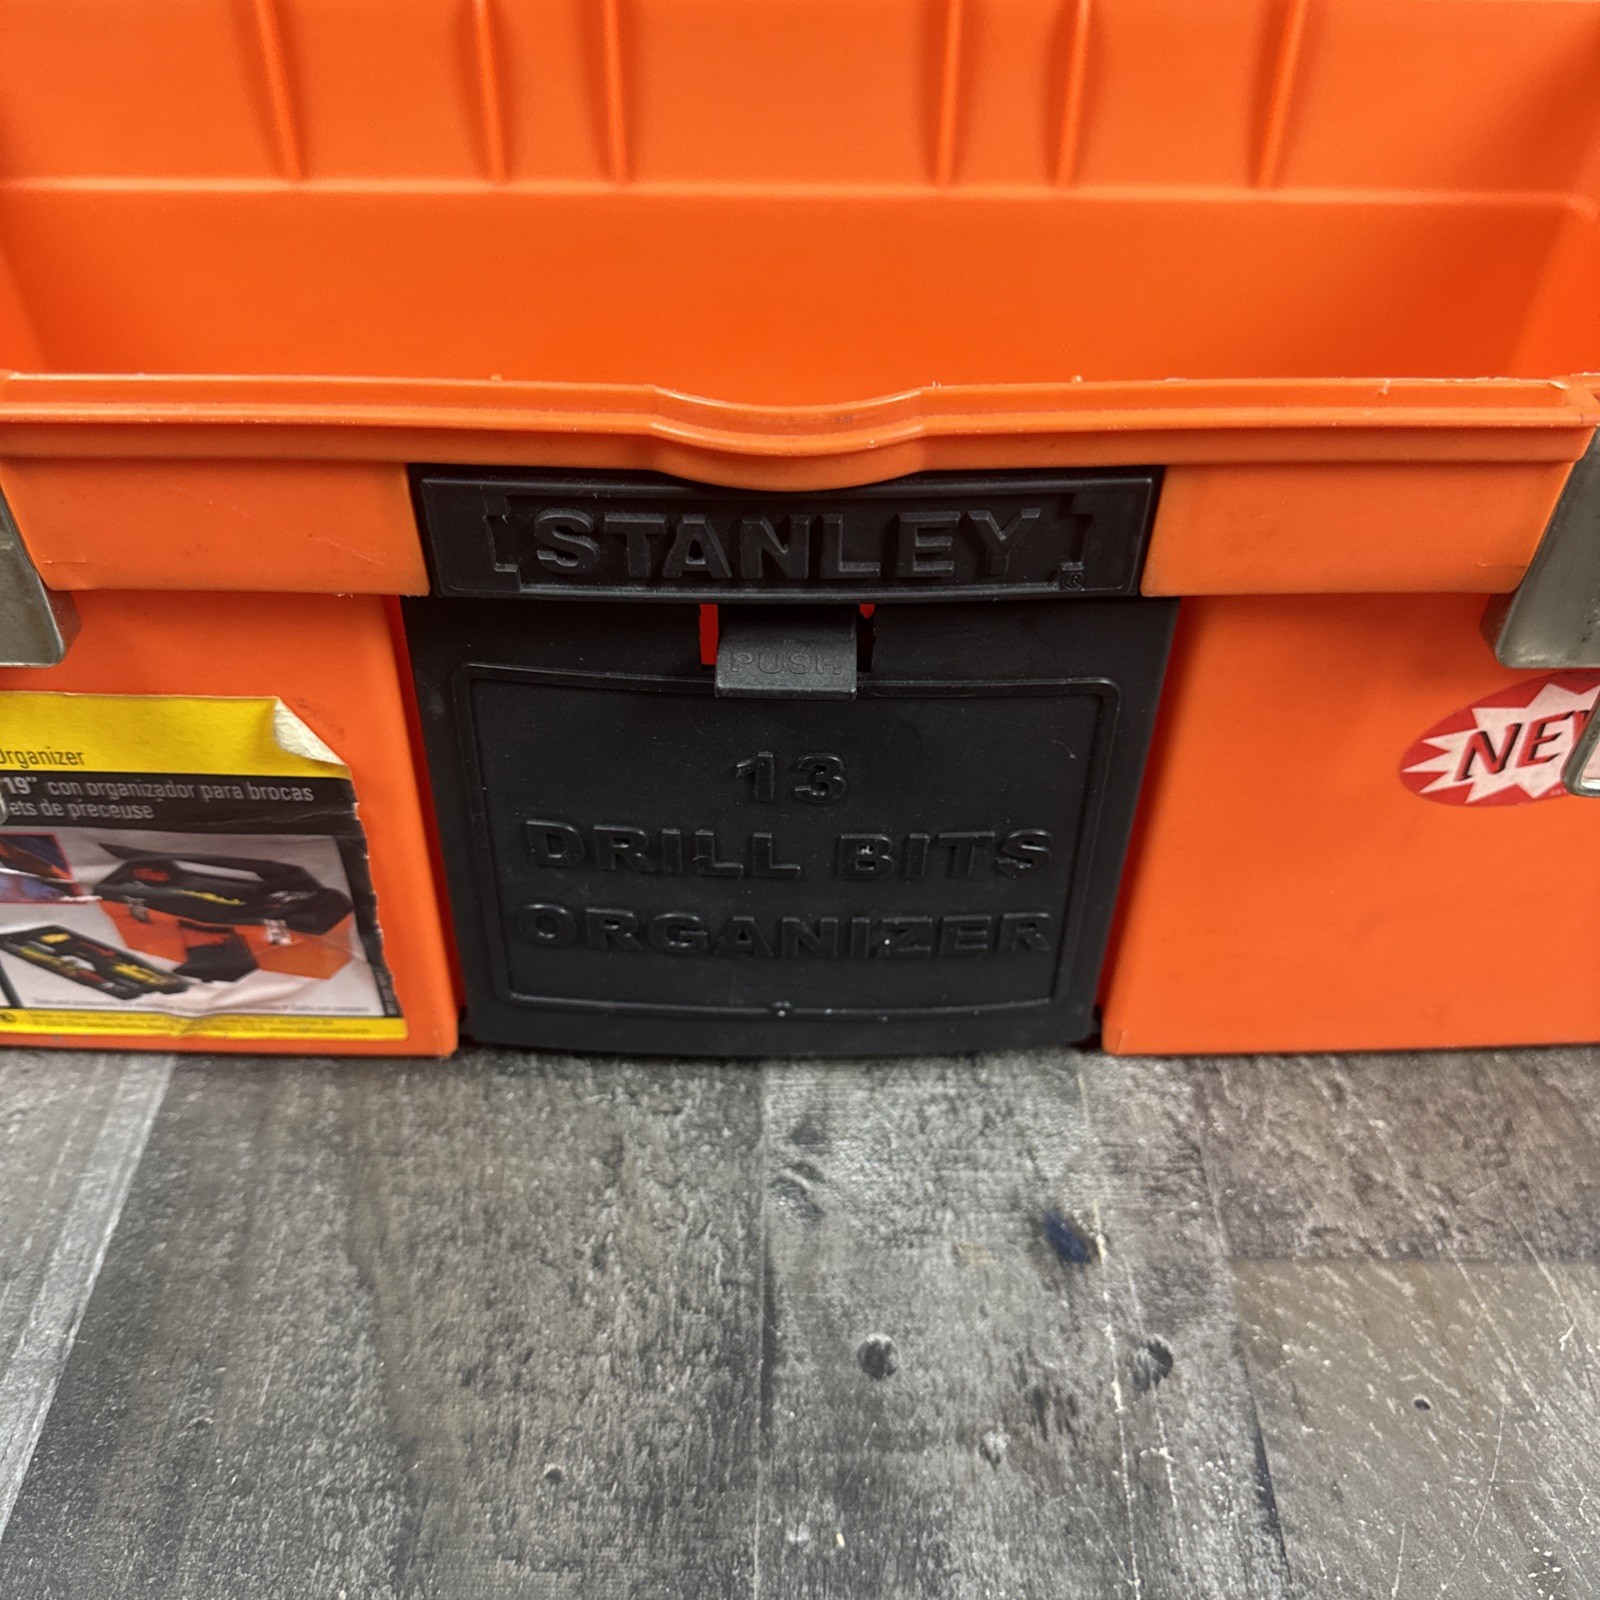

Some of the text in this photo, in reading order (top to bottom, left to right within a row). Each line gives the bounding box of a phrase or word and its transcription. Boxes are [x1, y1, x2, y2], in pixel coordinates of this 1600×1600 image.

[533, 506, 1043, 580] STANLEY
[729, 648, 844, 677] PUSH
[1453, 709, 1592, 783] NE
[47, 781, 84, 796] con
[86, 779, 195, 801] organizador
[200, 784, 244, 803] para
[246, 781, 315, 802] brocas
[735, 751, 847, 804] 13
[9, 799, 38, 816] ets
[40, 798, 65, 817] de
[524, 819, 1053, 880] DRILL BITS
[520, 902, 1053, 960] ORGANIZER
